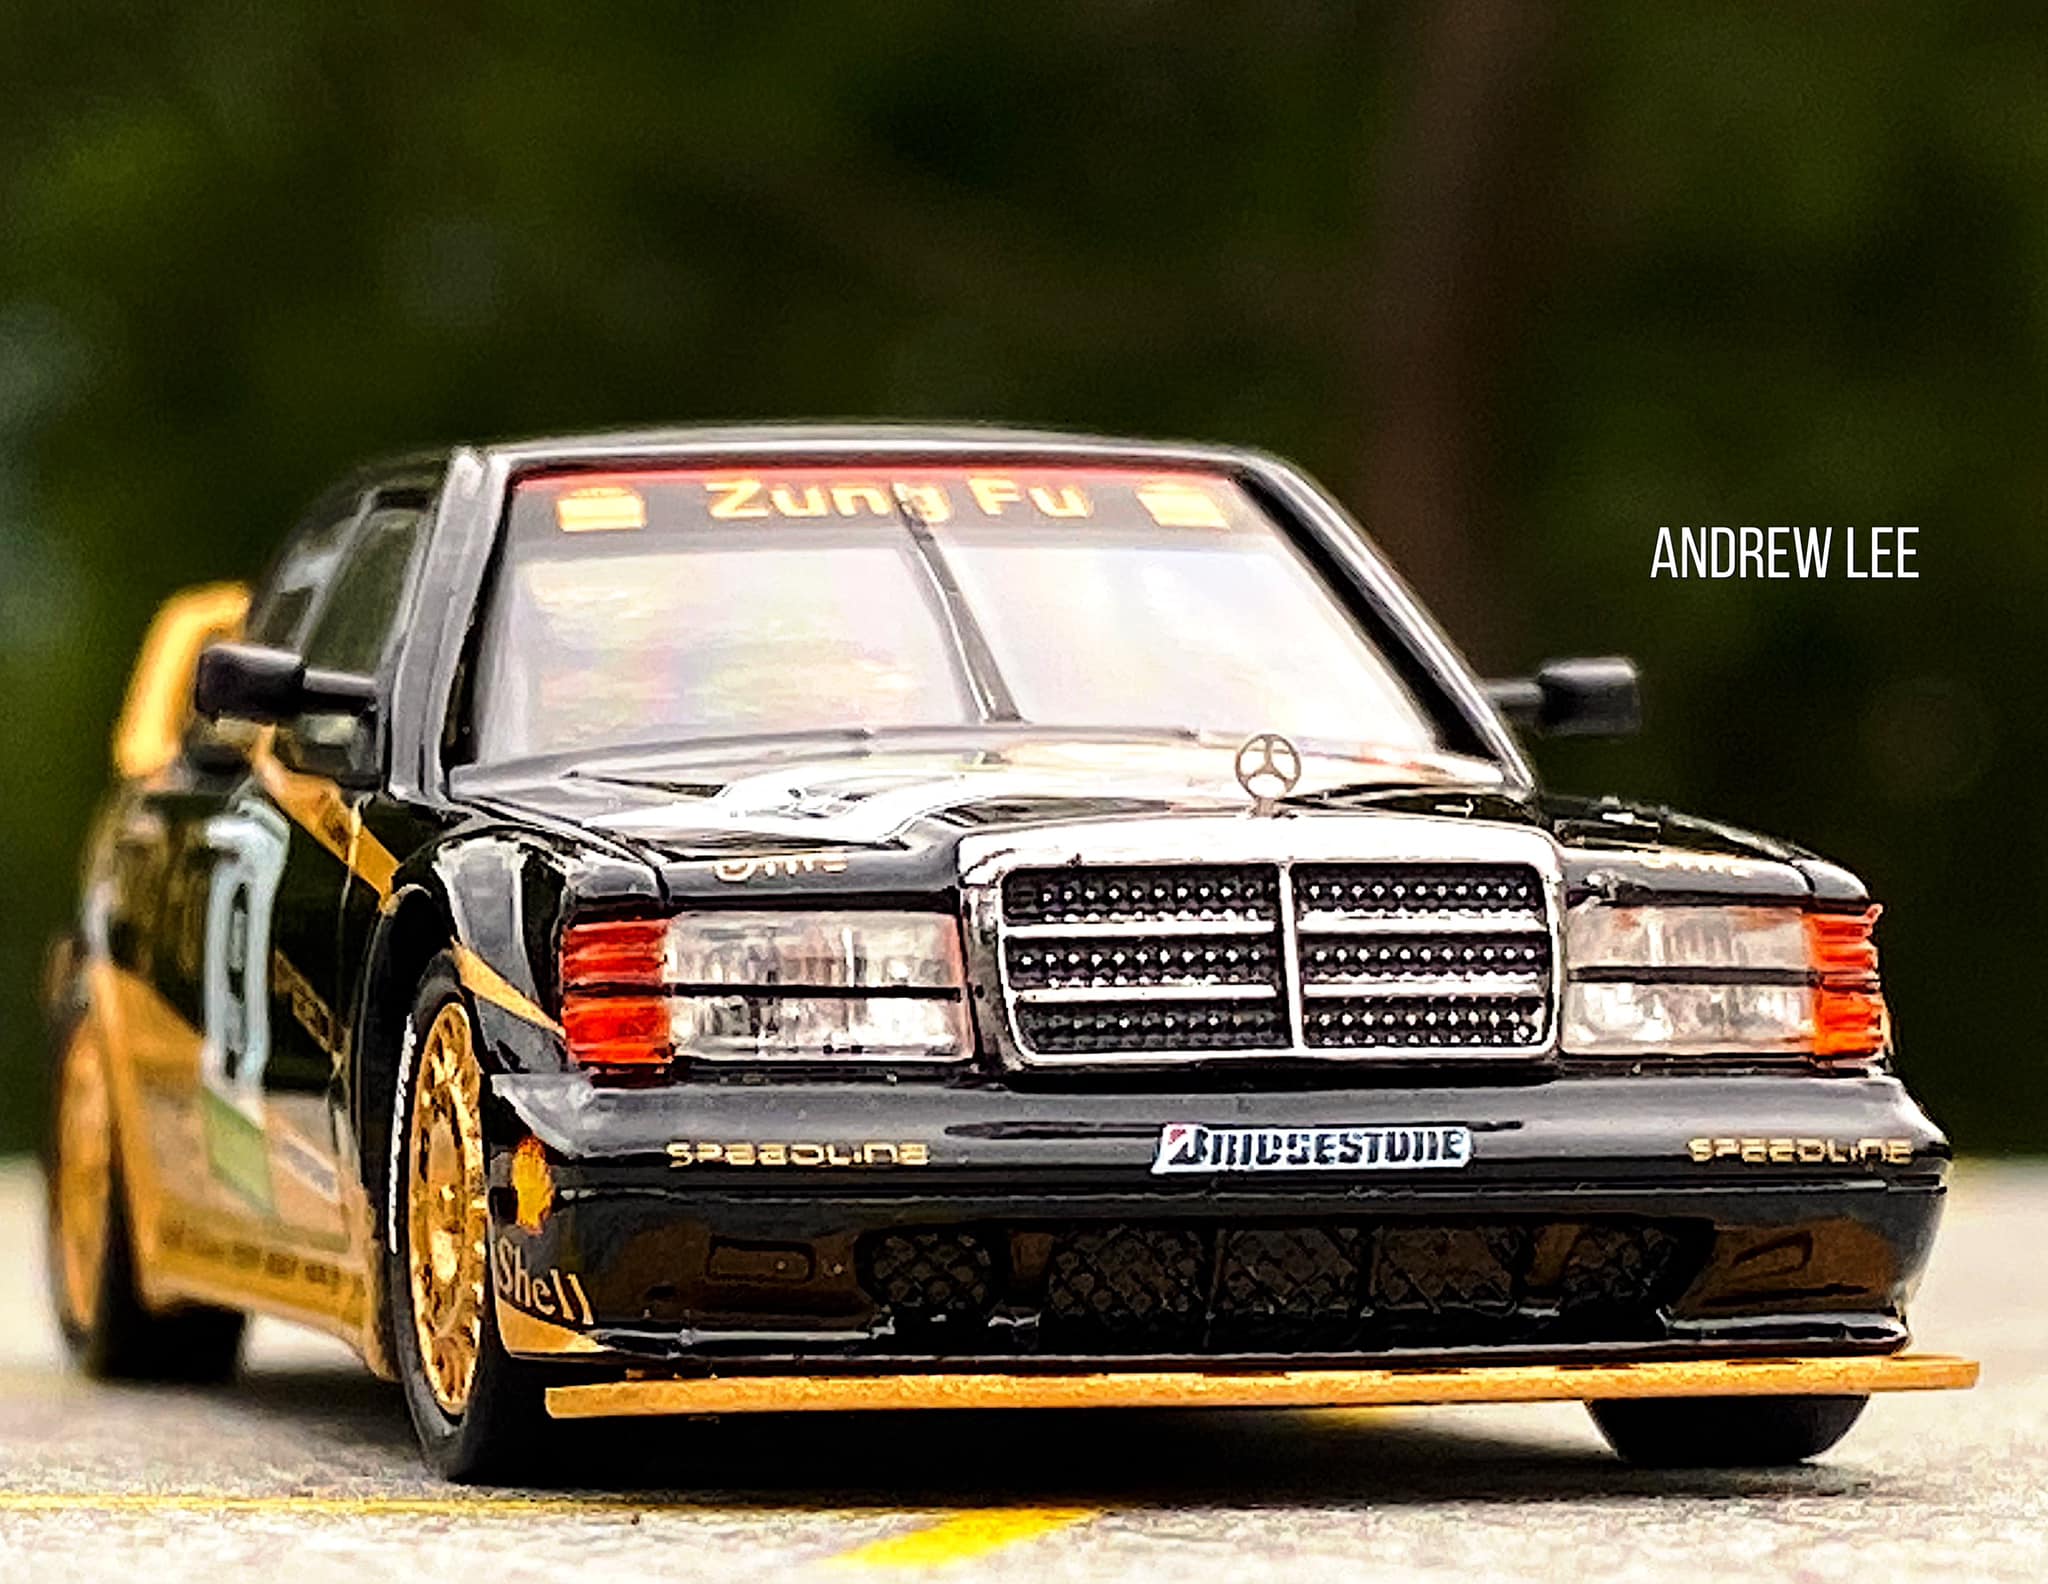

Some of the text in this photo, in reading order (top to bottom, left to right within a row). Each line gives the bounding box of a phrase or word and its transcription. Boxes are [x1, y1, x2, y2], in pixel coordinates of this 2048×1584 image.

[704, 475, 1090, 524] Zung Fu
[498, 1236, 594, 1326] Shell
